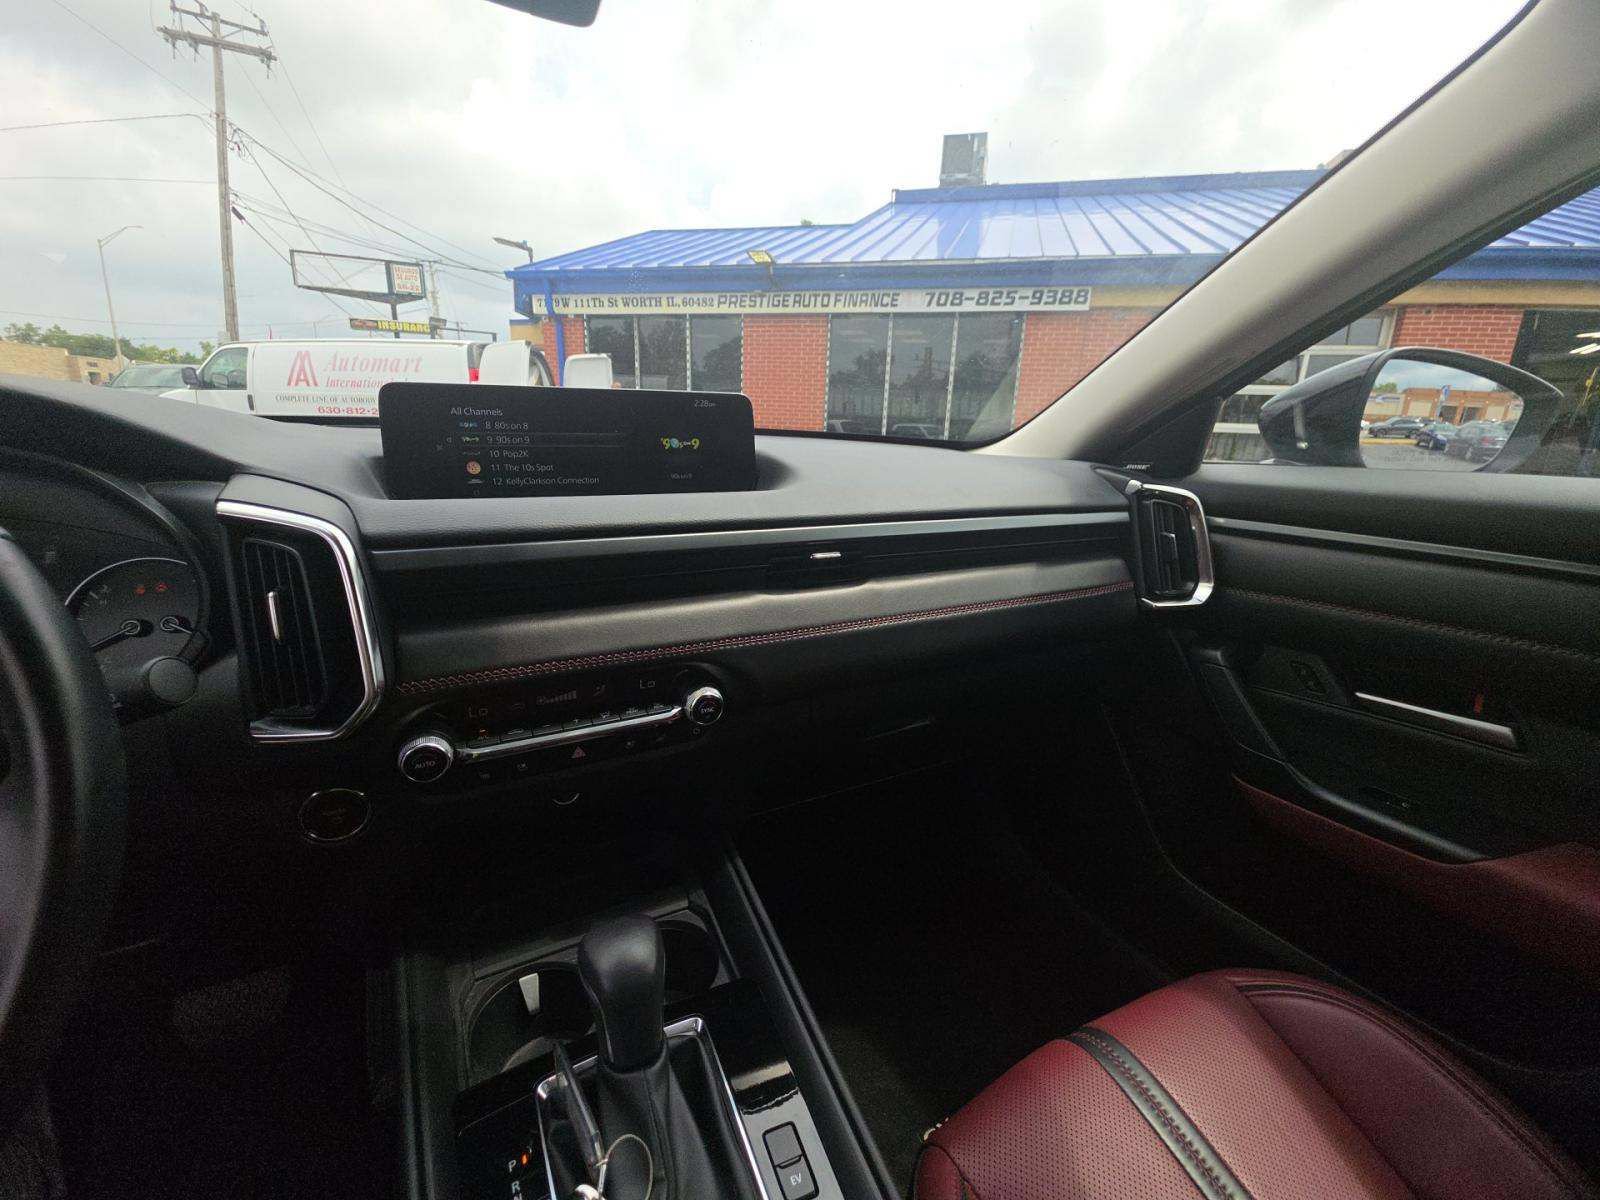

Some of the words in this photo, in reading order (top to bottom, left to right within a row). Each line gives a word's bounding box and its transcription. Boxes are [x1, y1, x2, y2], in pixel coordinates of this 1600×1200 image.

[607, 296, 619, 307] St
[621, 296, 662, 308] WORTH
[717, 293, 792, 309] PRESTIGE
[792, 293, 831, 309] AUTO
[833, 292, 901, 308] FINANCE
[925, 288, 1091, 308] 708-825-9388
[377, 321, 431, 334] INSURANC
[323, 351, 424, 373] Automart
[450, 407, 462, 416] All
[463, 407, 504, 416] Channels
[489, 450, 500, 458] 10
[536, 464, 554, 474] Spot
[493, 478, 503, 486] 12
[558, 477, 600, 486] Connection
[507, 1159, 517, 1173] P
[790, 1172, 802, 1186] EV
[511, 1180, 521, 1194] R
